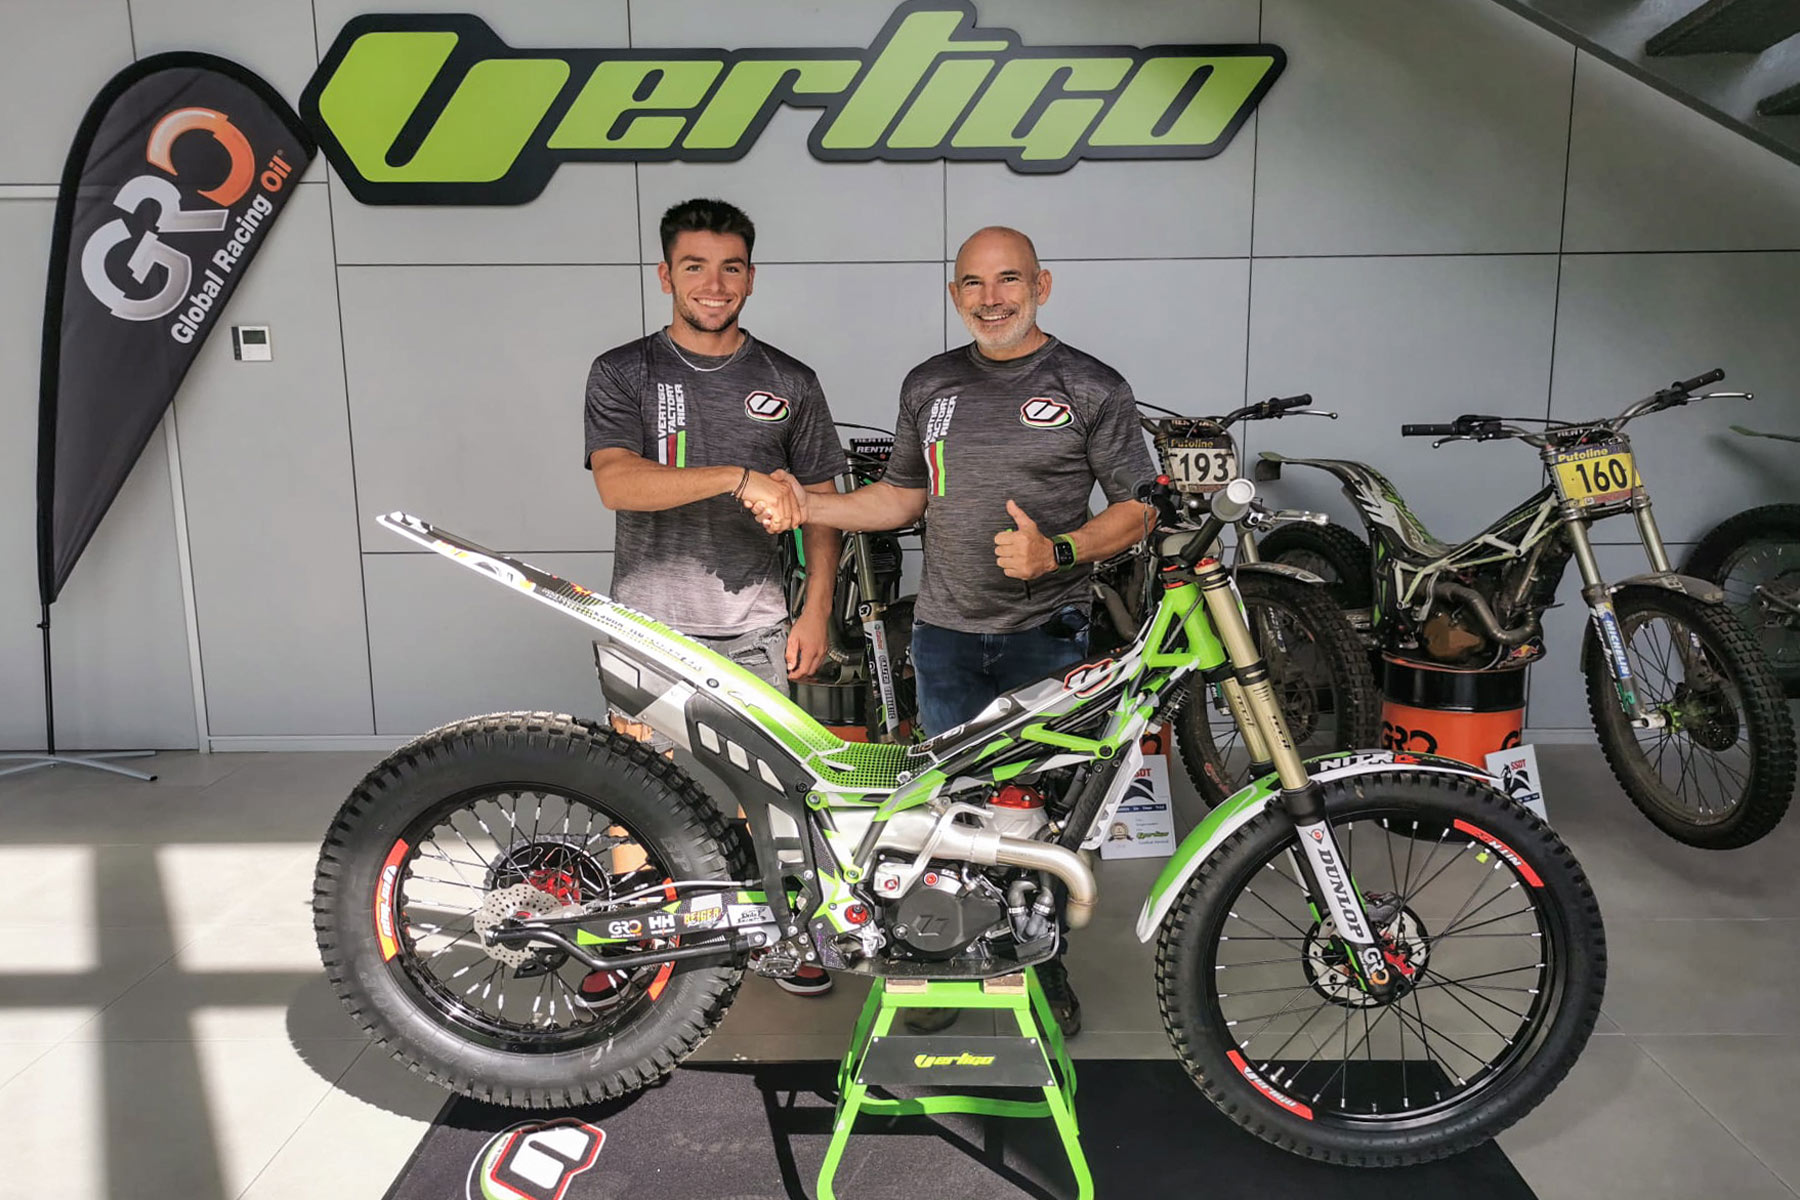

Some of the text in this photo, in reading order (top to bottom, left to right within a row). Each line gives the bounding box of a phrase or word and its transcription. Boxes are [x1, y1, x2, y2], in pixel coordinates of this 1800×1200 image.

[81, 106, 255, 322] GRO
[170, 154, 293, 344] Global Racing Oil
[657, 383, 668, 438] VERTIGO
[666, 383, 677, 434] FACTORY
[674, 383, 686, 427] RIDER
[939, 395, 958, 436] RIDER
[1179, 452, 1229, 482] 193
[1557, 447, 1609, 463] Putoline
[1575, 458, 1628, 493] 160
[1604, 619, 1631, 676] MICHELIN
[1317, 848, 1365, 940] DUNLOP
[607, 919, 642, 935] GRO
[1363, 946, 1390, 986] GRO
